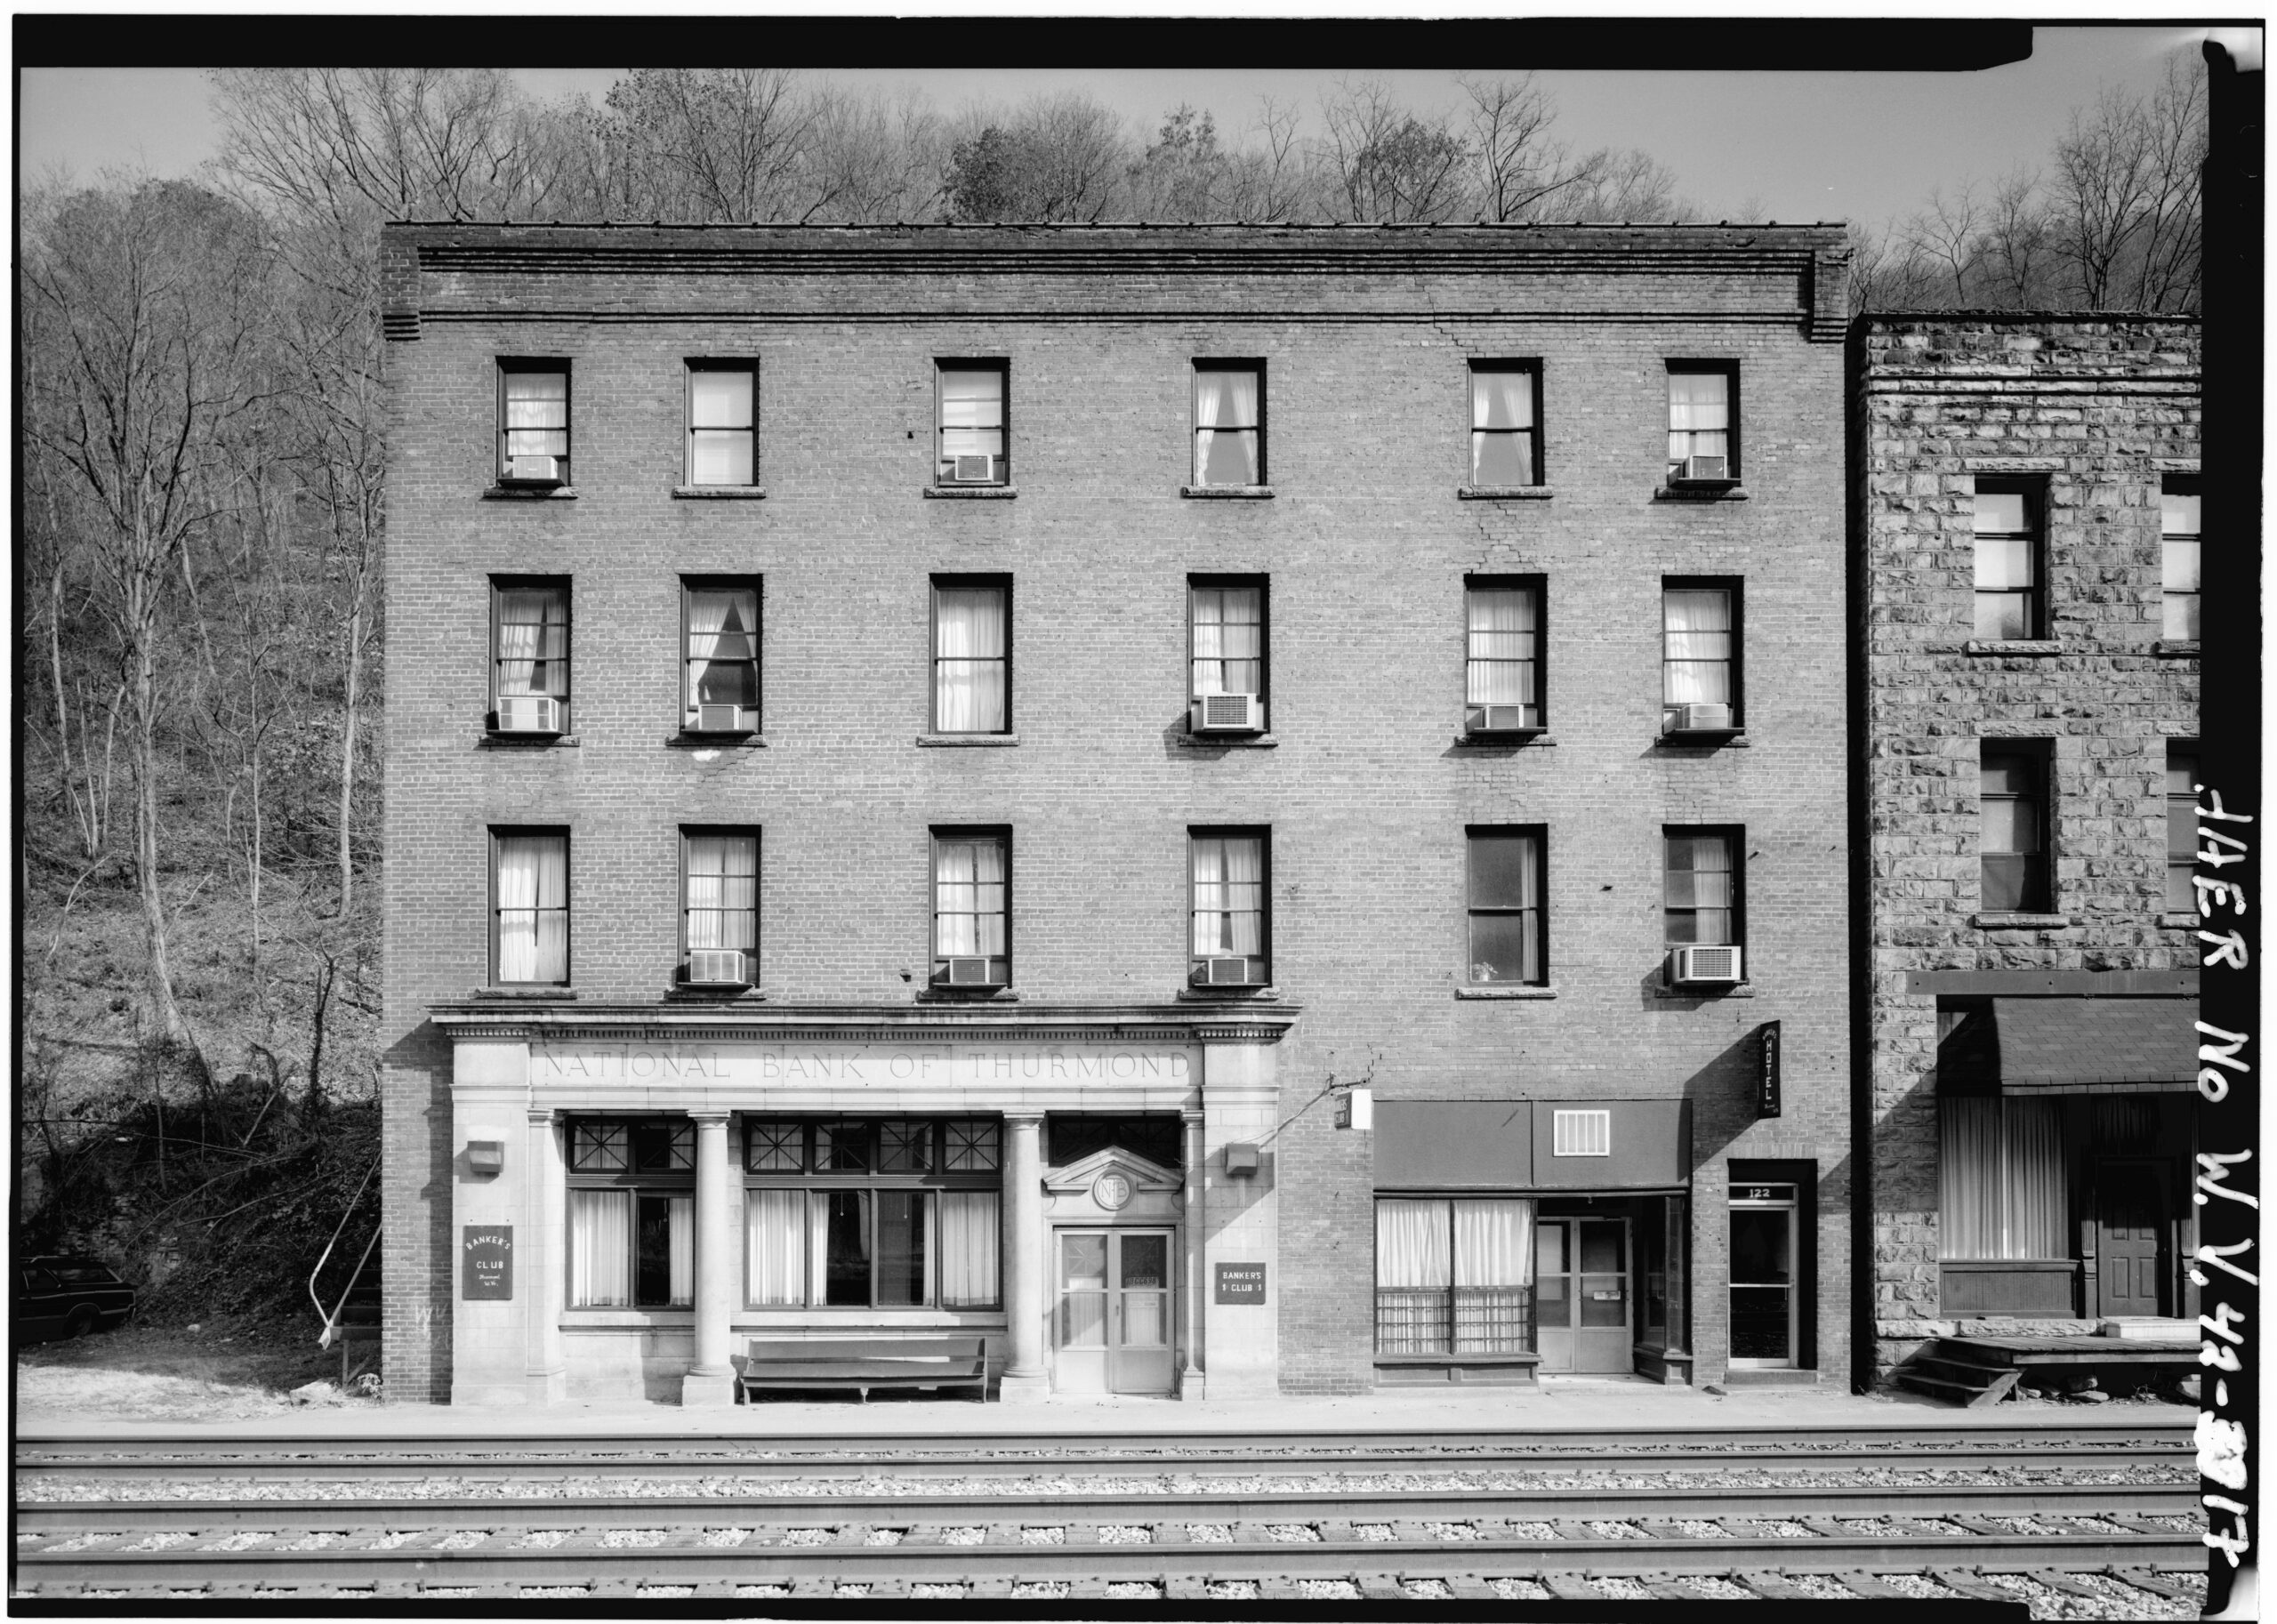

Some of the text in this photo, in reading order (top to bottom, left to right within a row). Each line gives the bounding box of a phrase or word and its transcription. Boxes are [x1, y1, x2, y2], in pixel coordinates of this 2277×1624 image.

[543, 1051, 1191, 1079] NATIONAL BANK OF THURMOND
[1749, 1188, 1770, 1198] 122
[465, 1235, 511, 1250] BANKER'S
[476, 1260, 504, 1270] CLUB
[1231, 1283, 1252, 1292] CLUB
